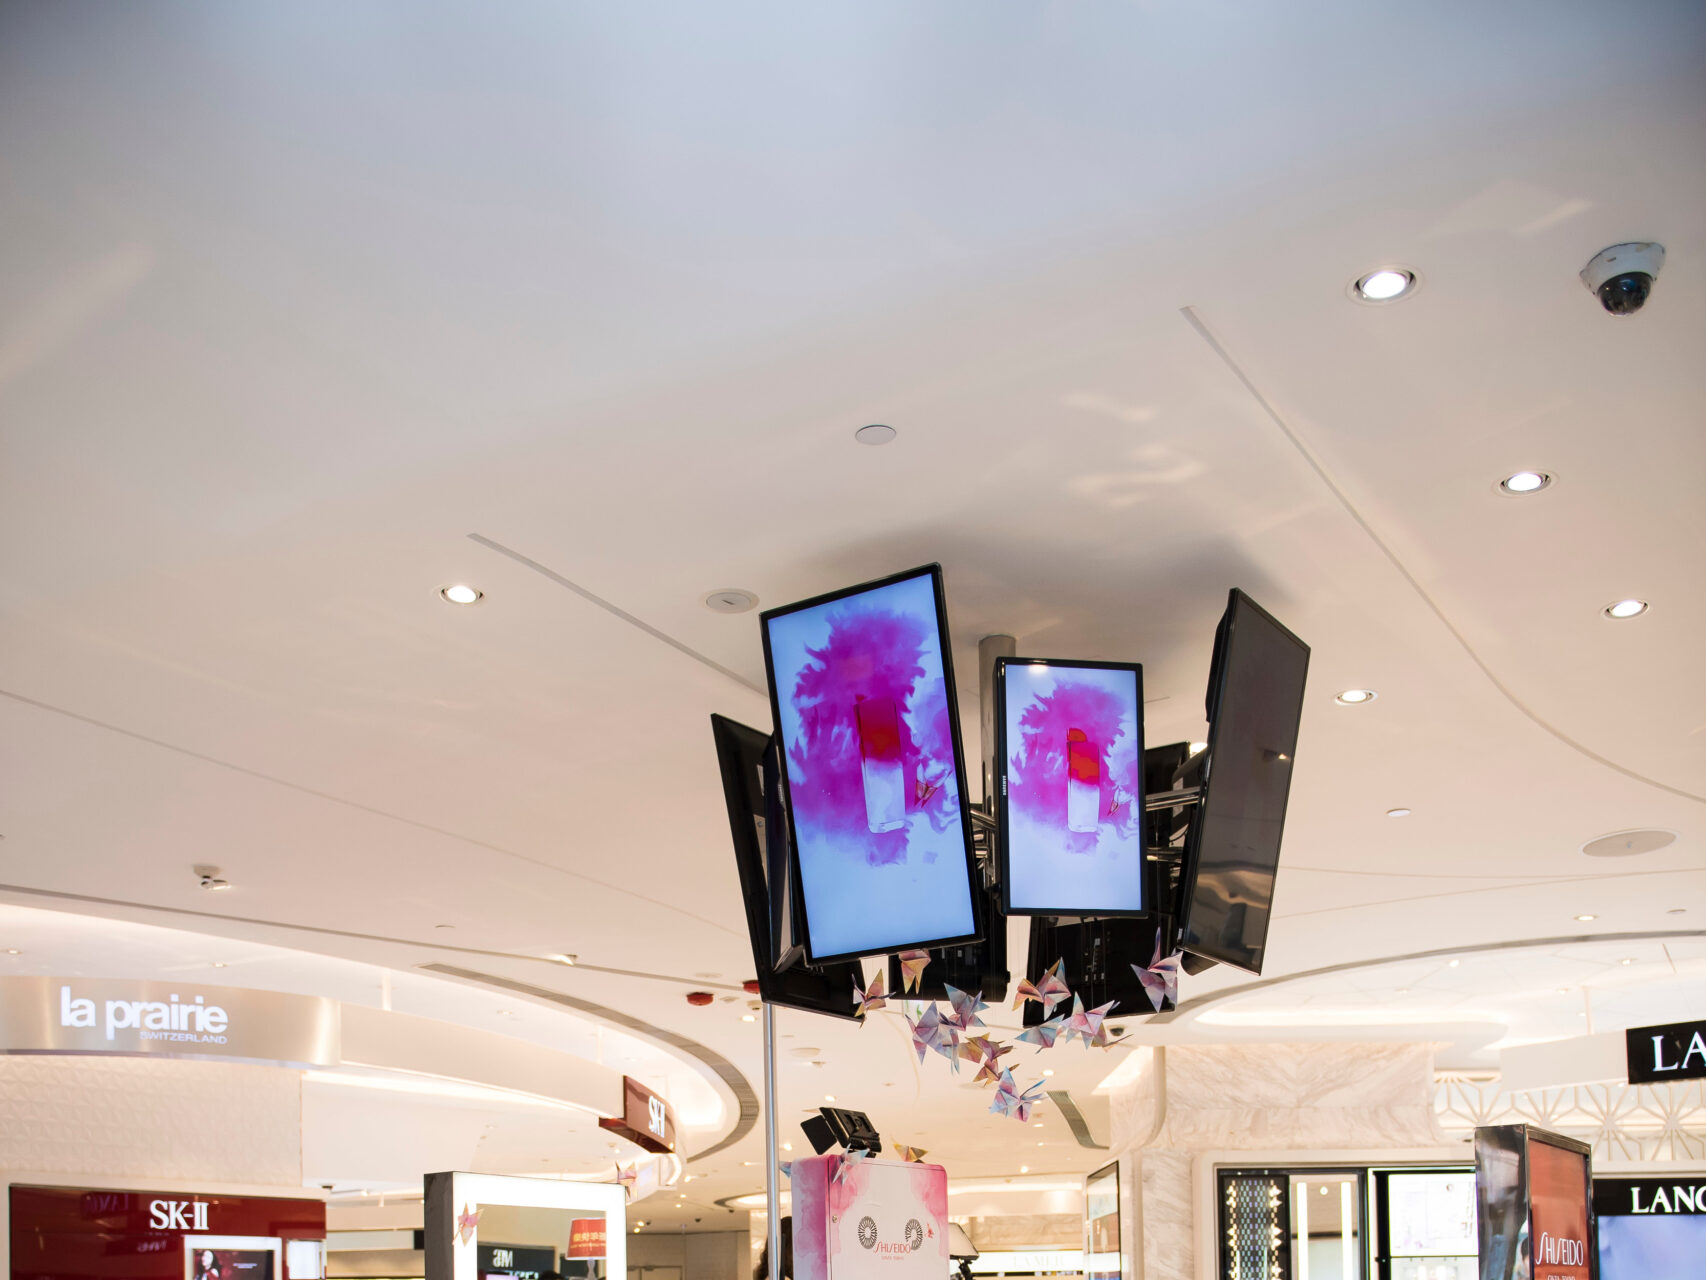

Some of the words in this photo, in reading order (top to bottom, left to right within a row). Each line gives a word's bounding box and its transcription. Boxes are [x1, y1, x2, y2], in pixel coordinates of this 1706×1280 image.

[60, 986, 96, 1027] la
[105, 993, 228, 1041] prairie
[139, 1030, 227, 1045] SWITZERLAND
[149, 1199, 210, 1231] SK-II
[874, 1241, 912, 1254] SHISEIDO
[1535, 1231, 1584, 1266] SHISEIDO
